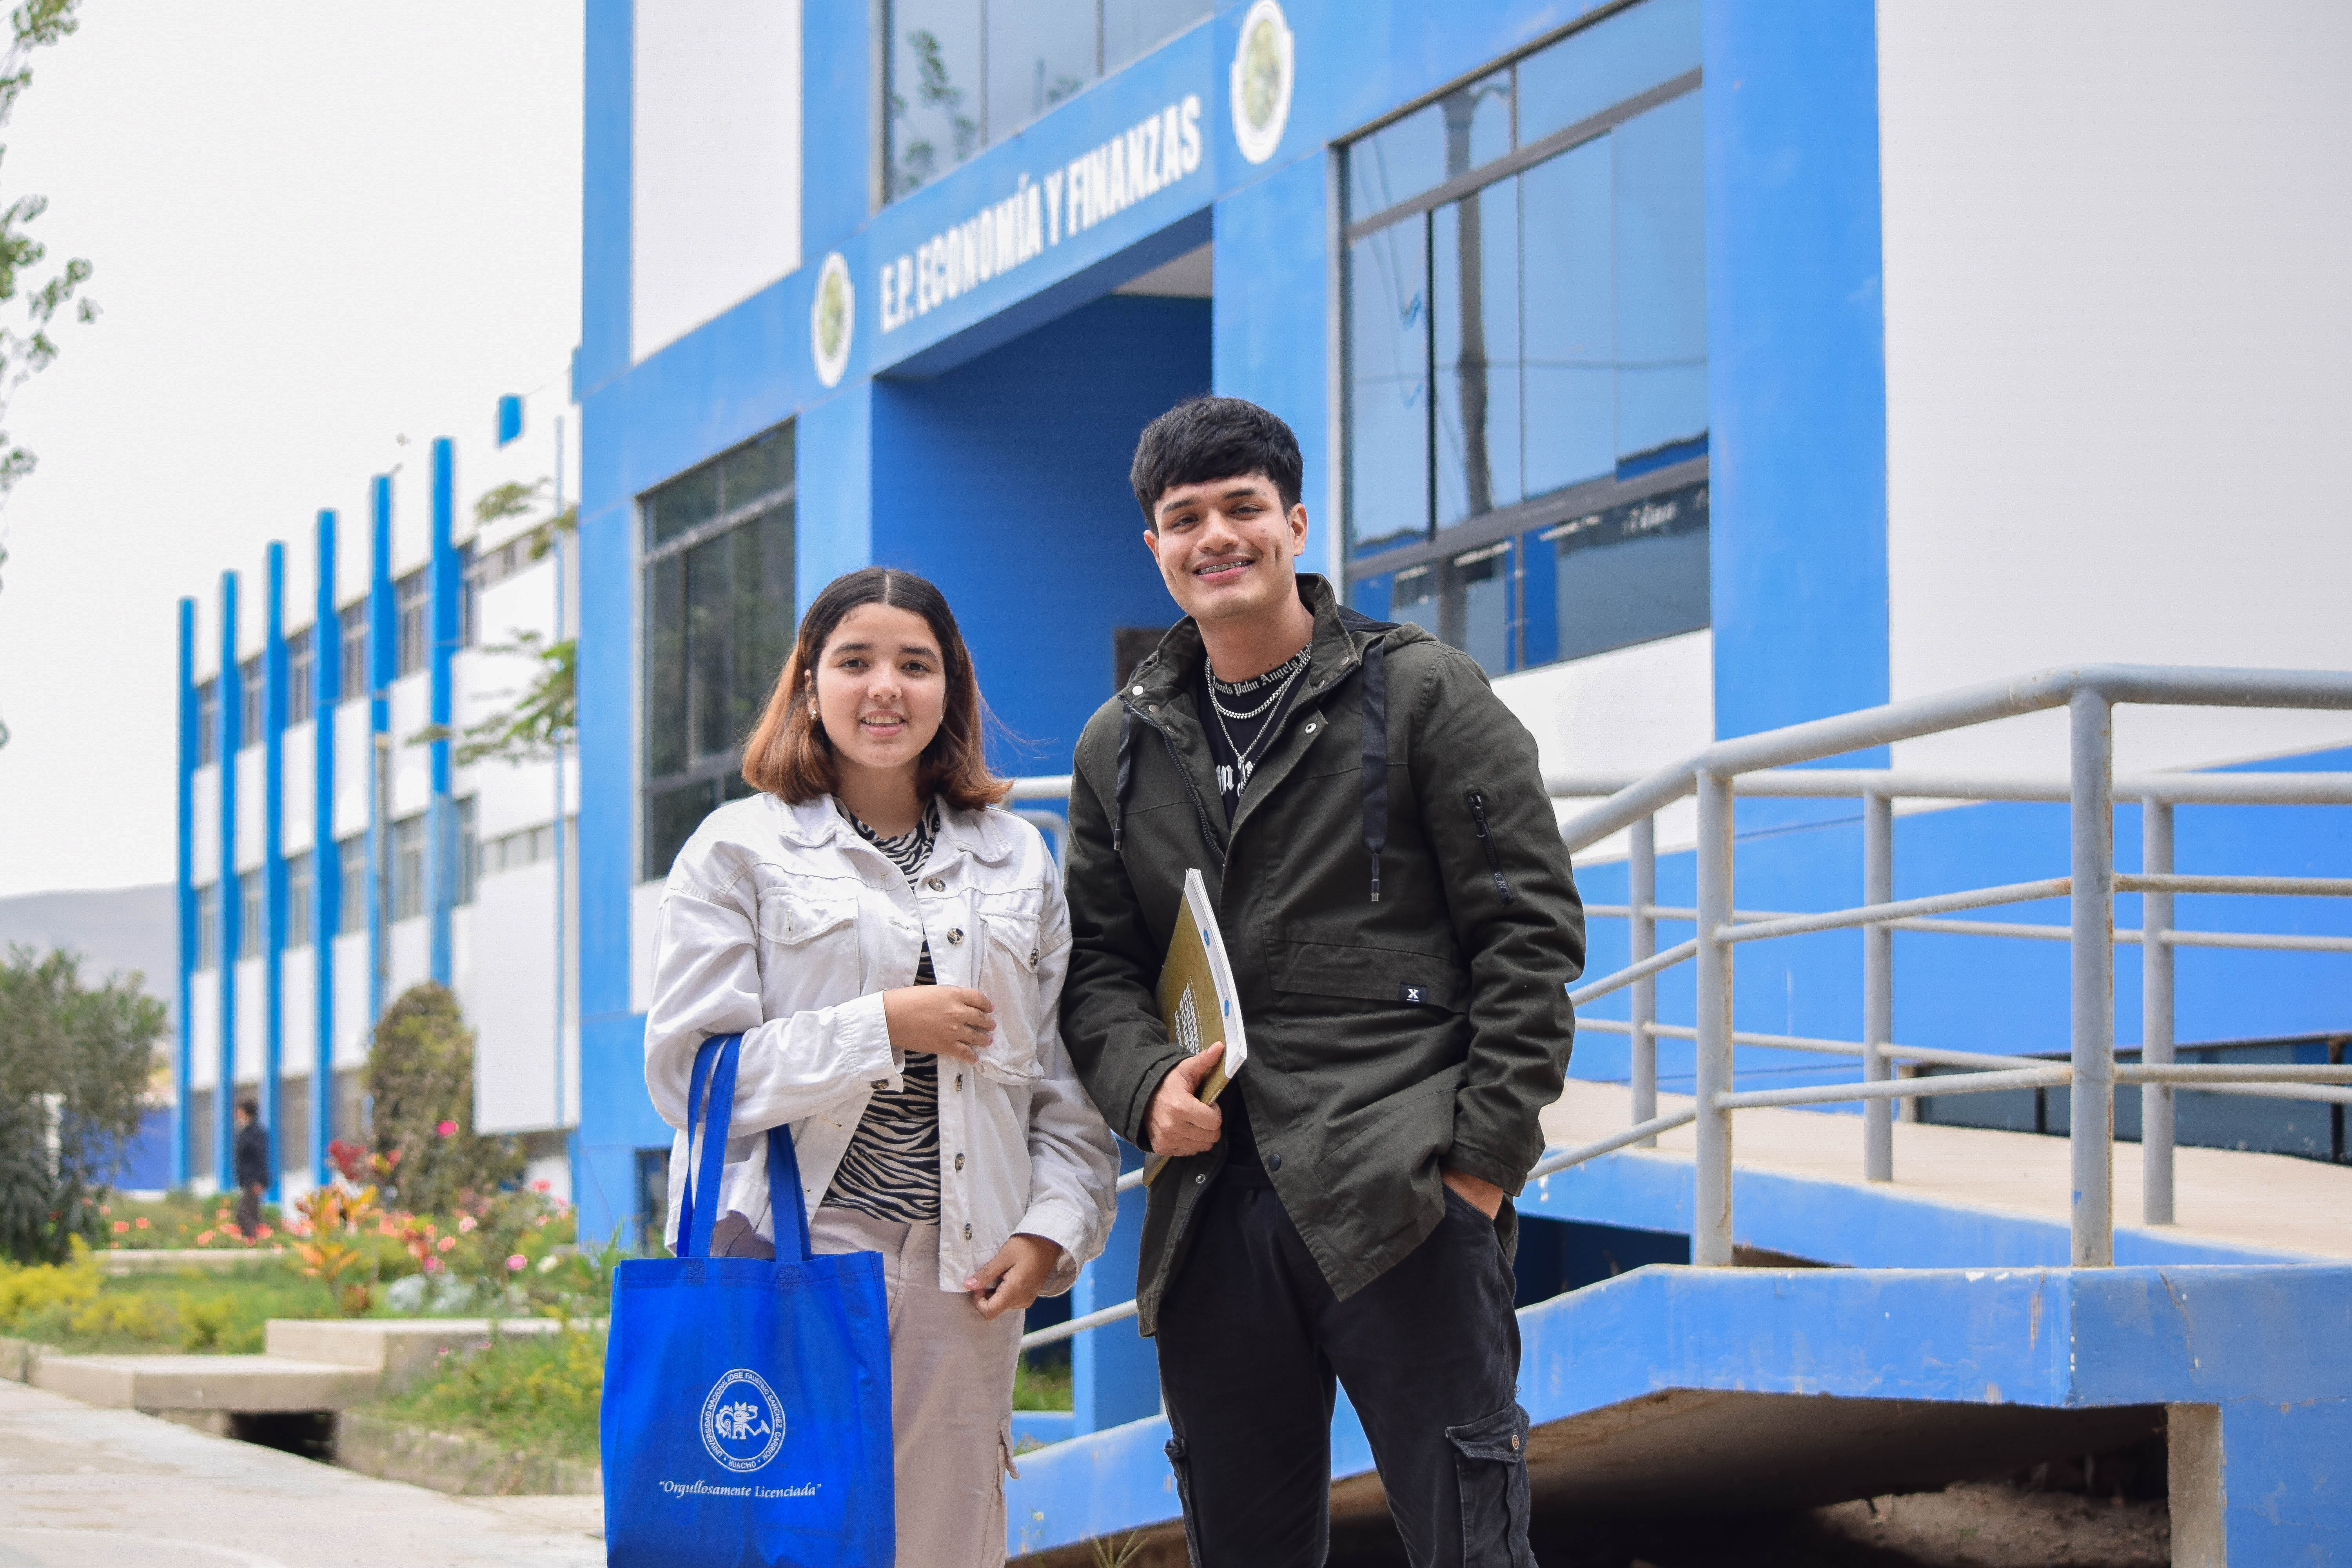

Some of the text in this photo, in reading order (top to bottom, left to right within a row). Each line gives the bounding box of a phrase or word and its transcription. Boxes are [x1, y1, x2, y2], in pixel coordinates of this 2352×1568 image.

[879, 93, 1201, 336] E.P. ECONOMÍA Y FINANZAS
[1174, 1010, 1184, 1047] ación
[1185, 982, 1200, 1055] rofesional
[705, 1372, 782, 1460] UNIVERSIDAD NACIONAL JOSE FAUSTINO SANCHEZ CARRION
[729, 1460, 756, 1468] HUACHO
